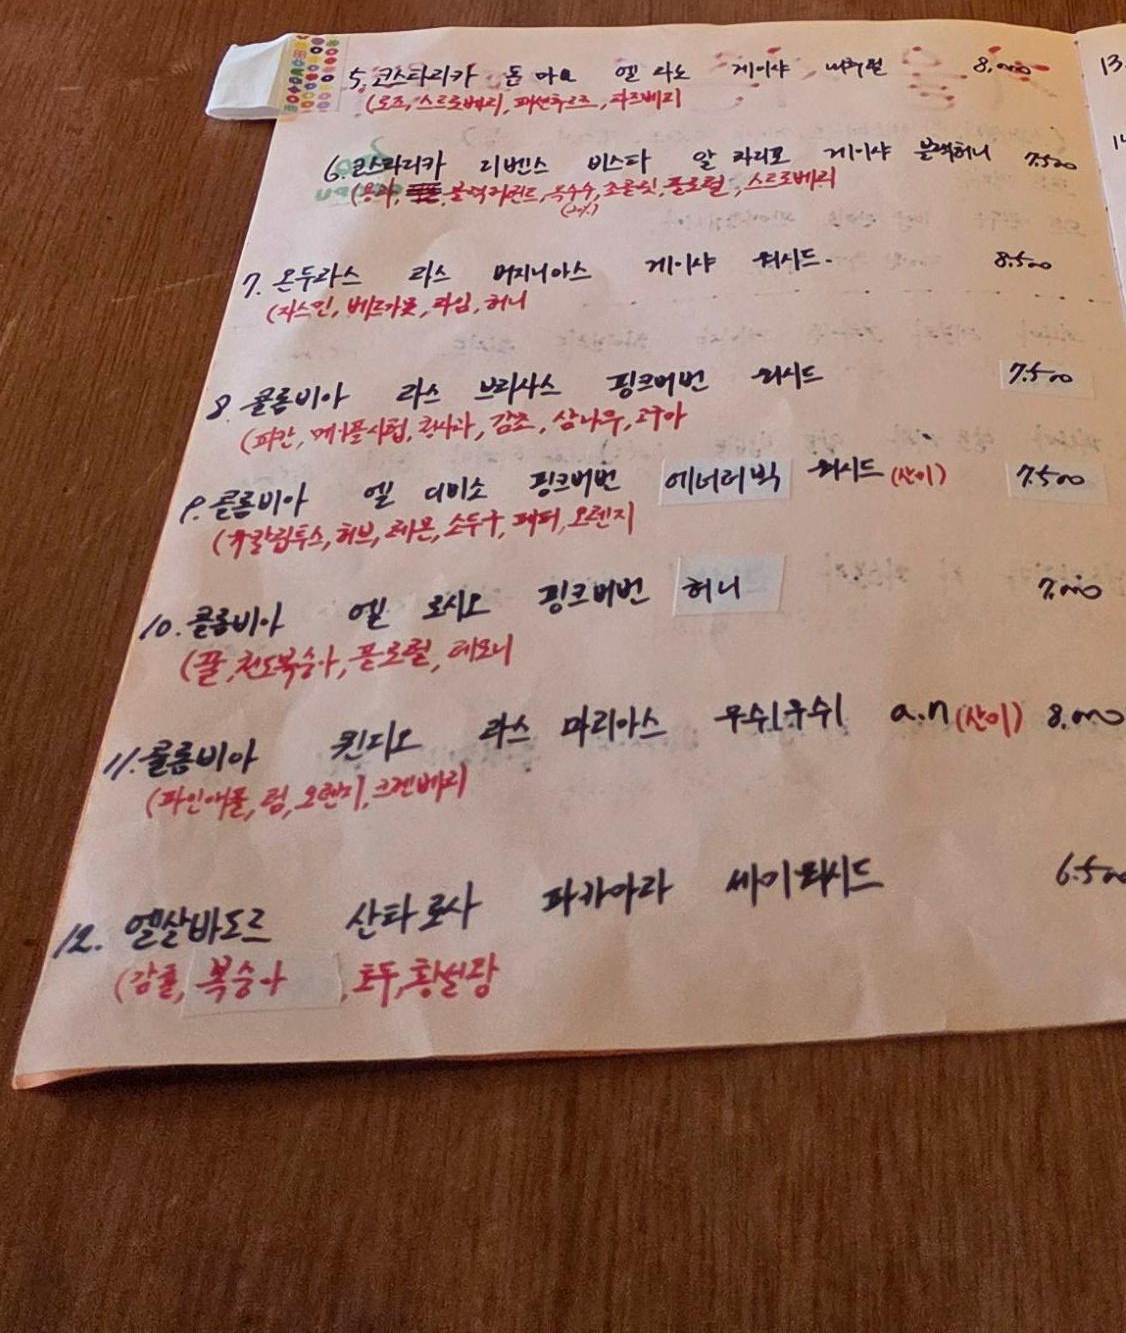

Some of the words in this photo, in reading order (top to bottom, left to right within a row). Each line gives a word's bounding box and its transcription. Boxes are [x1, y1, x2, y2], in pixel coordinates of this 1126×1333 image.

[323, 154, 346, 183] 6.
[242, 271, 262, 300] 7.
[271, 262, 363, 294] 온두라스
[407, 259, 452, 289] 라스
[644, 251, 717, 277] 게이샤
[483, 289, 528, 312] 허니
[395, 376, 441, 411] 라스
[363, 480, 396, 511] 엘
[347, 596, 390, 631] 엘
[680, 574, 741, 605] 허니
[477, 711, 531, 750] 라스
